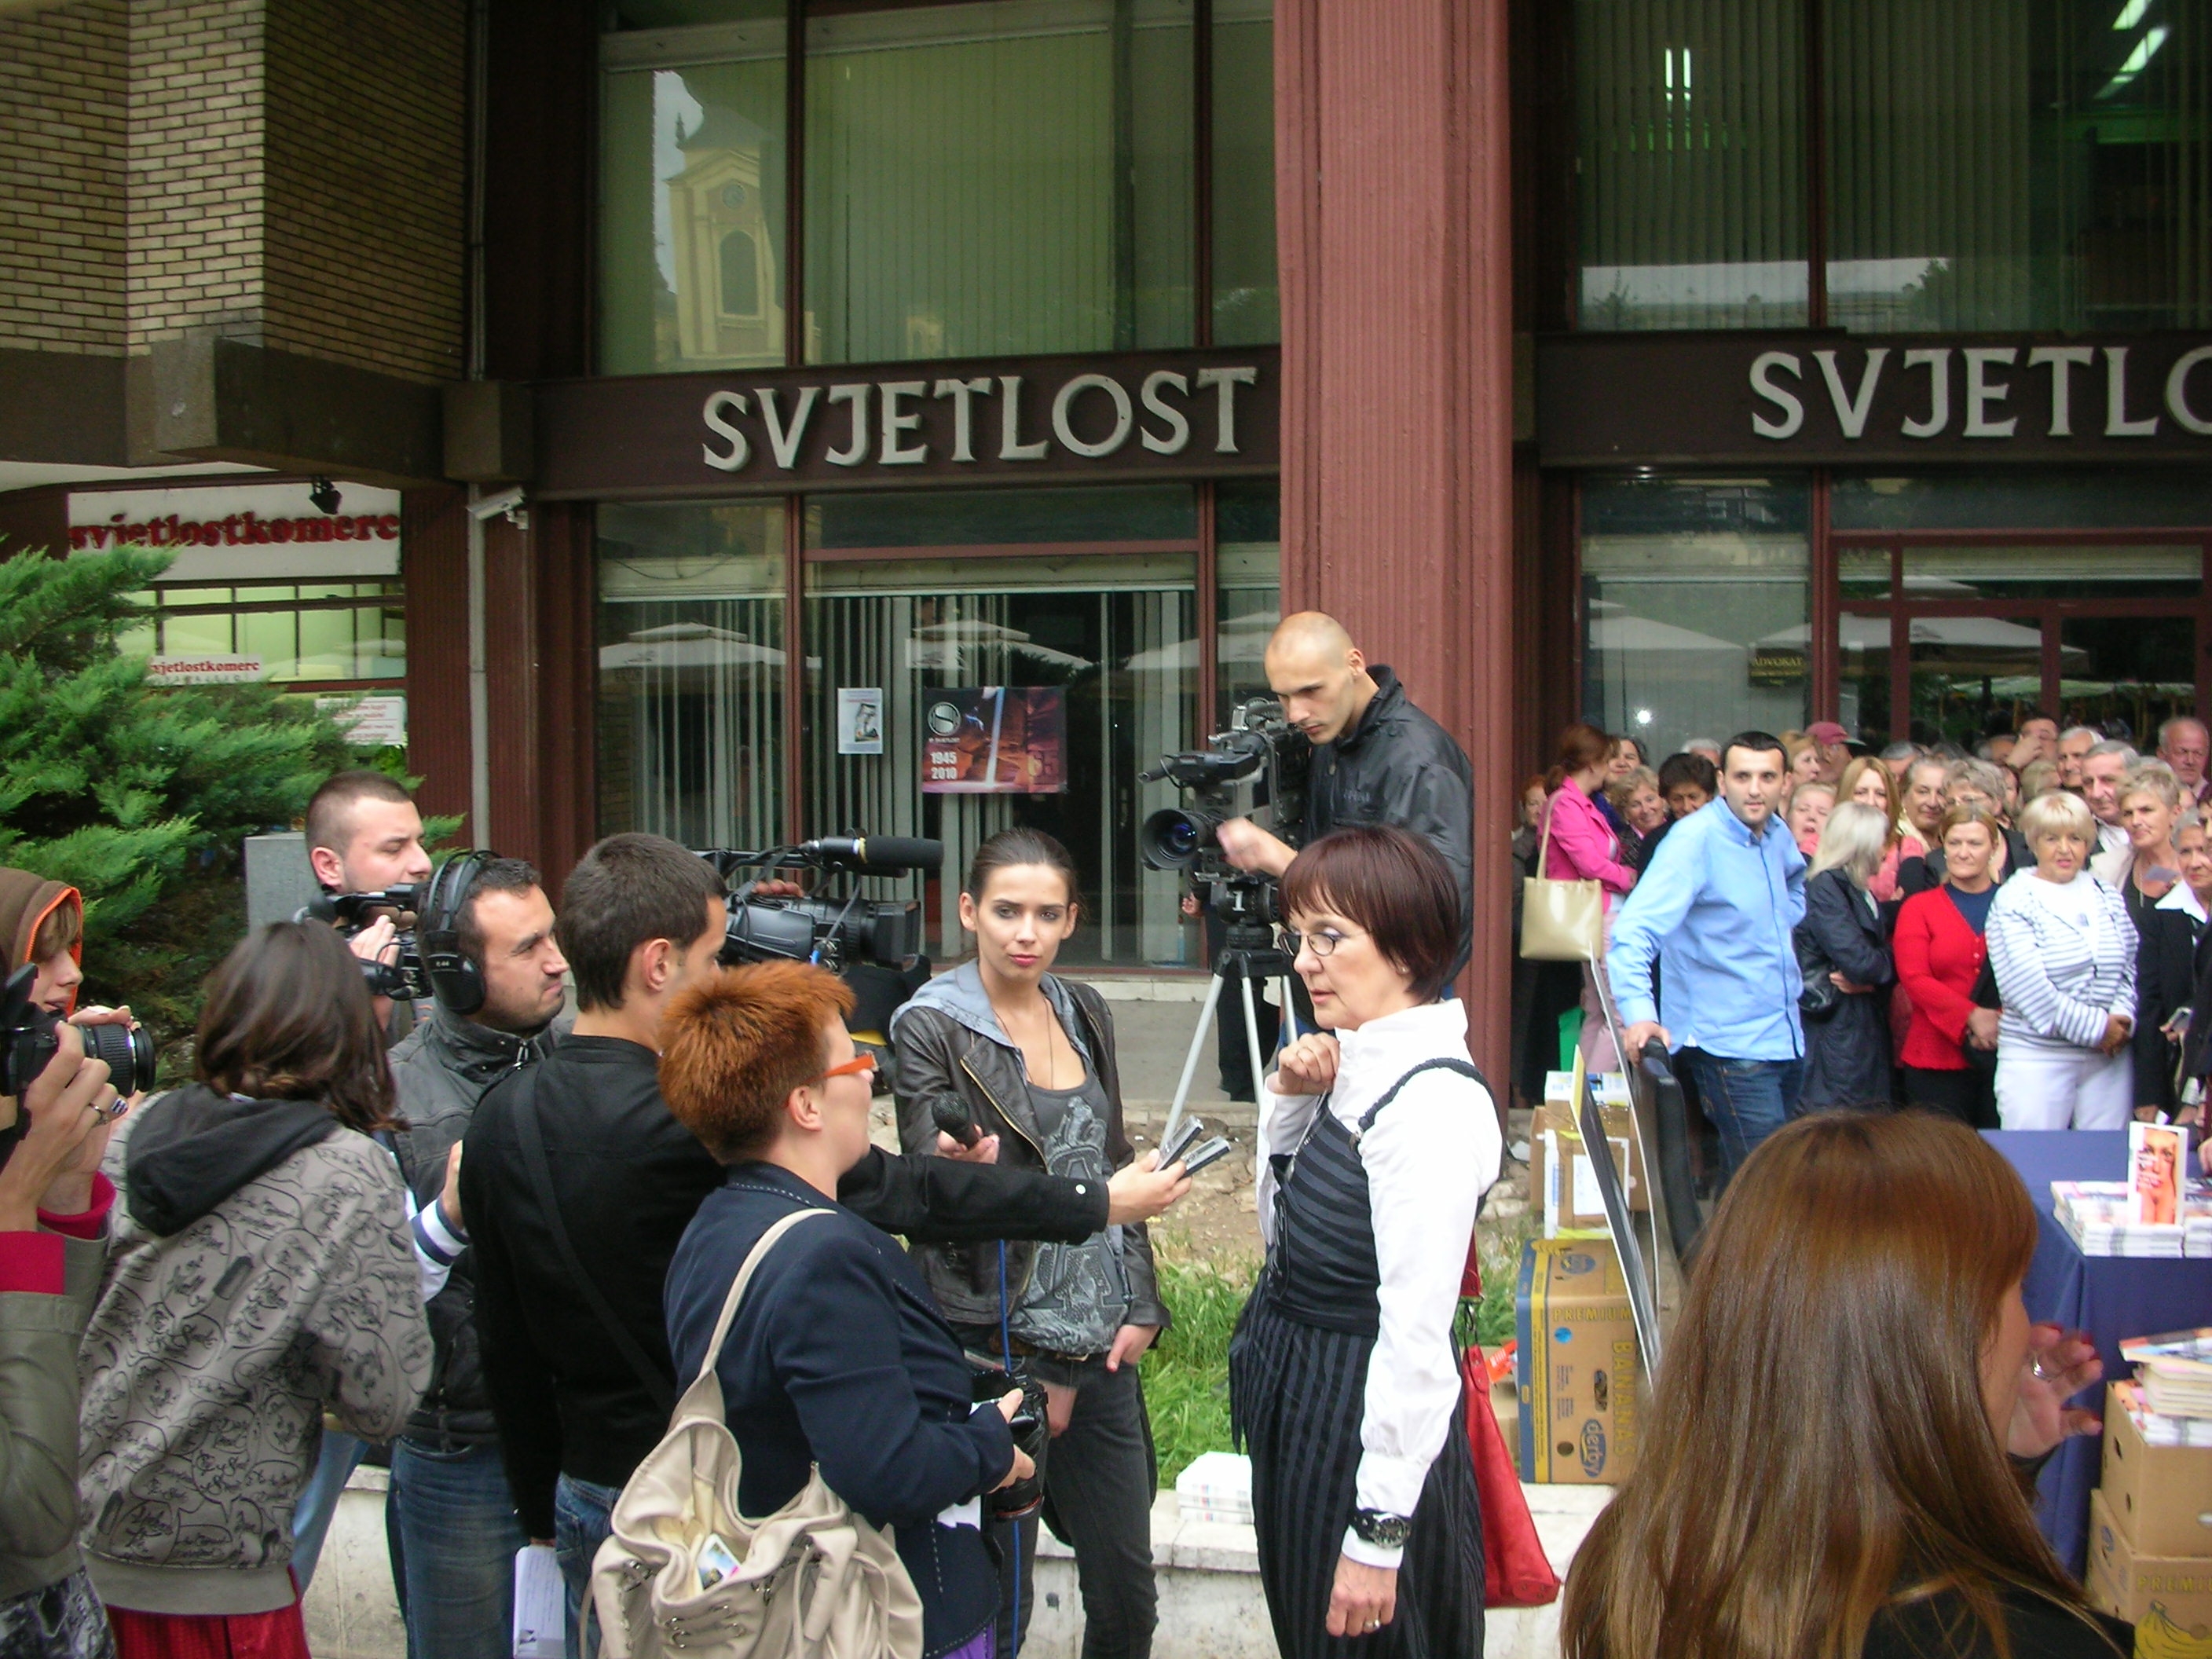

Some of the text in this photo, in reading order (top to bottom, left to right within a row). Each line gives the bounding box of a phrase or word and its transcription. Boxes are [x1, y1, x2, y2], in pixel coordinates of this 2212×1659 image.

[702, 367, 1257, 471] SVJETLOST
[930, 751, 958, 764] 1945
[931, 767, 958, 780] 2010
[1232, 891, 1246, 912] 1
[1553, 1306, 1632, 1321] PREMIUM
[1613, 1341, 1636, 1456] BANANAS
[2137, 1575, 2212, 1594] PREMI
